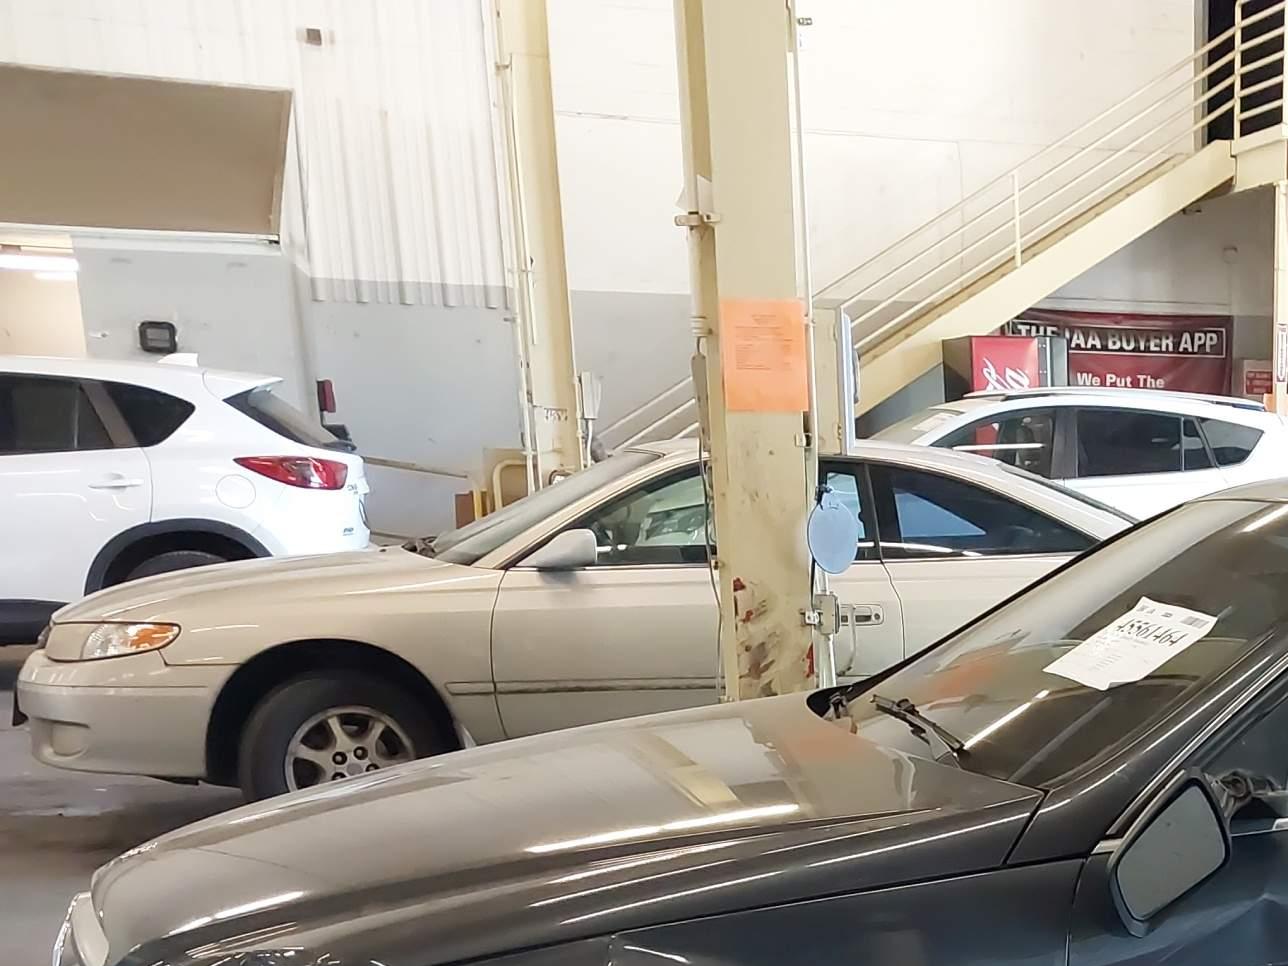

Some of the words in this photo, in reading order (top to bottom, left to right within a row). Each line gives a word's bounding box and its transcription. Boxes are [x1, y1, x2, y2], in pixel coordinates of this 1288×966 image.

[1107, 332, 1174, 352] BUYER
[1178, 332, 1218, 353] APP
[1077, 372, 1101, 386] We
[1105, 373, 1132, 387] Put
[1136, 374, 1165, 388] The
